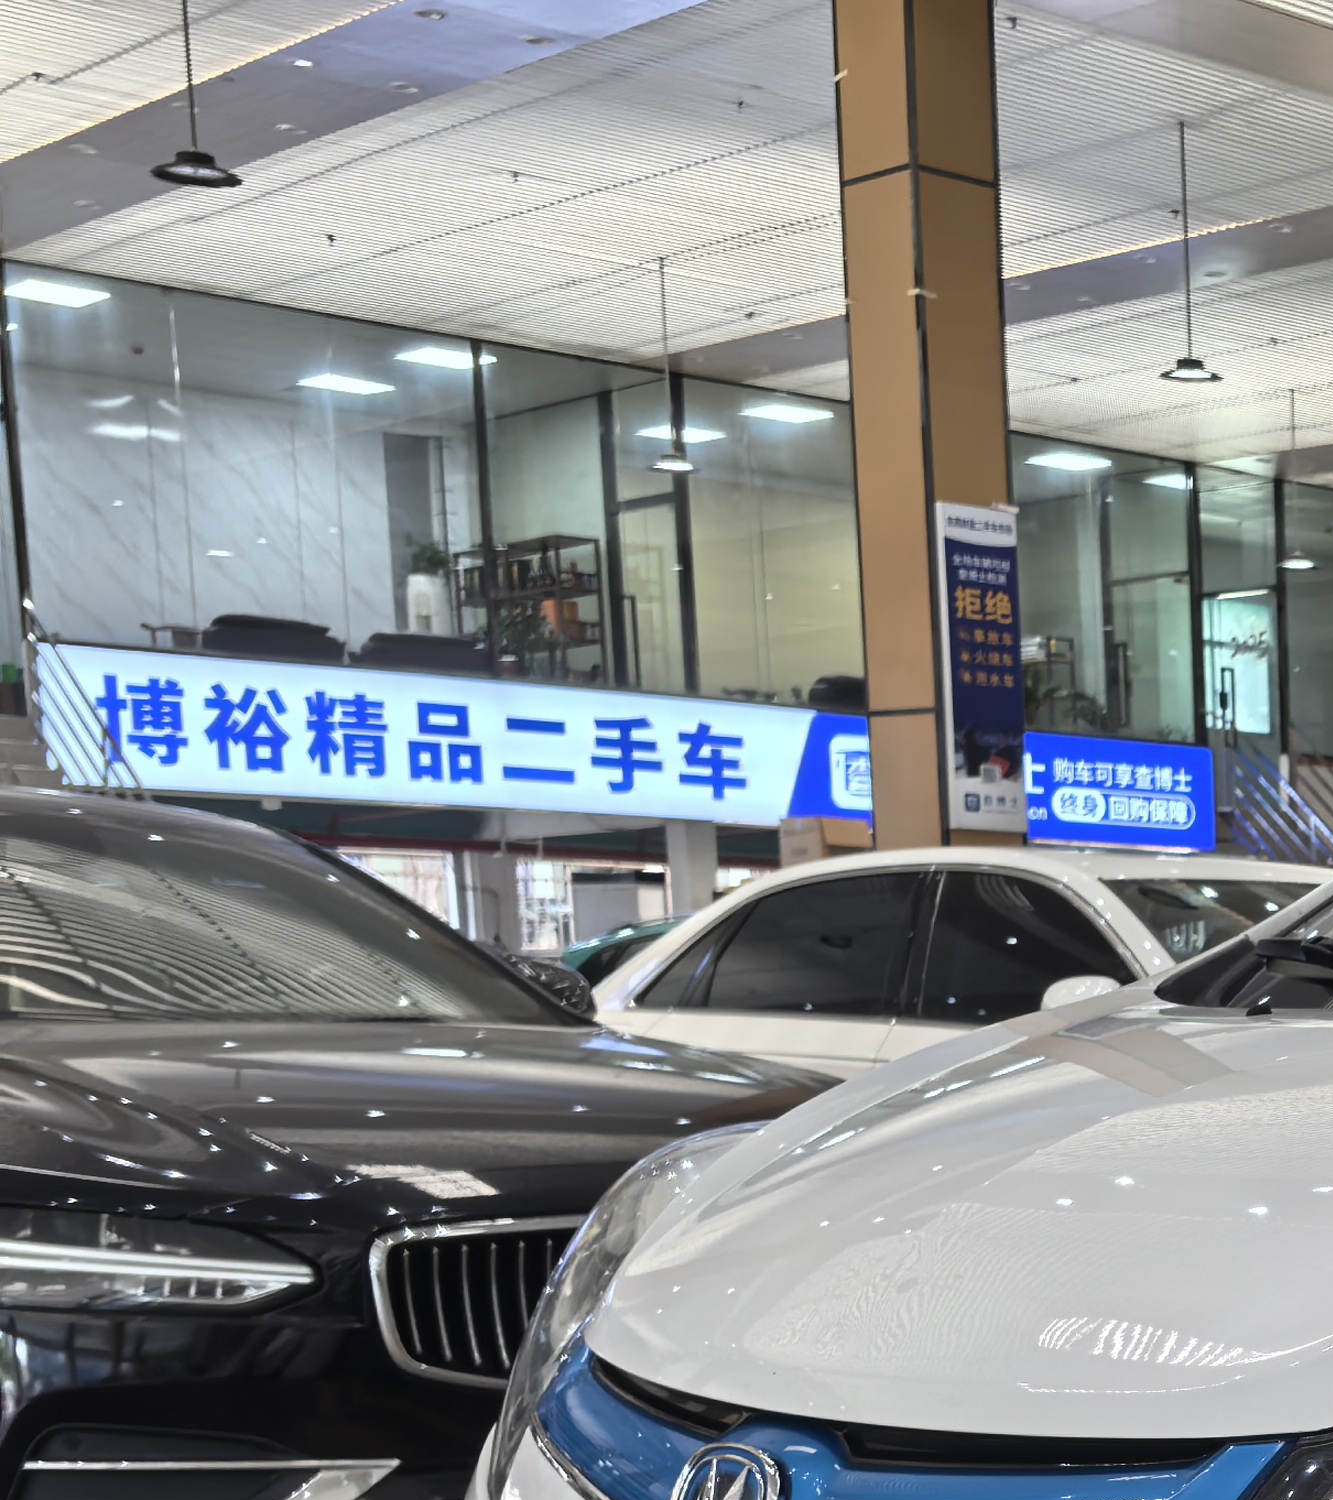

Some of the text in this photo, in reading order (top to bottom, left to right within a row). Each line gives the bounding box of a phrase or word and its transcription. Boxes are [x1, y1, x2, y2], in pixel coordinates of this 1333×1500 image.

[954, 585, 1013, 625] 拒绝
[97, 674, 748, 800] 博裕精品二手车
[1053, 757, 1193, 793] 购车可享查博士
[1060, 792, 1189, 826] 终身 回购保障
